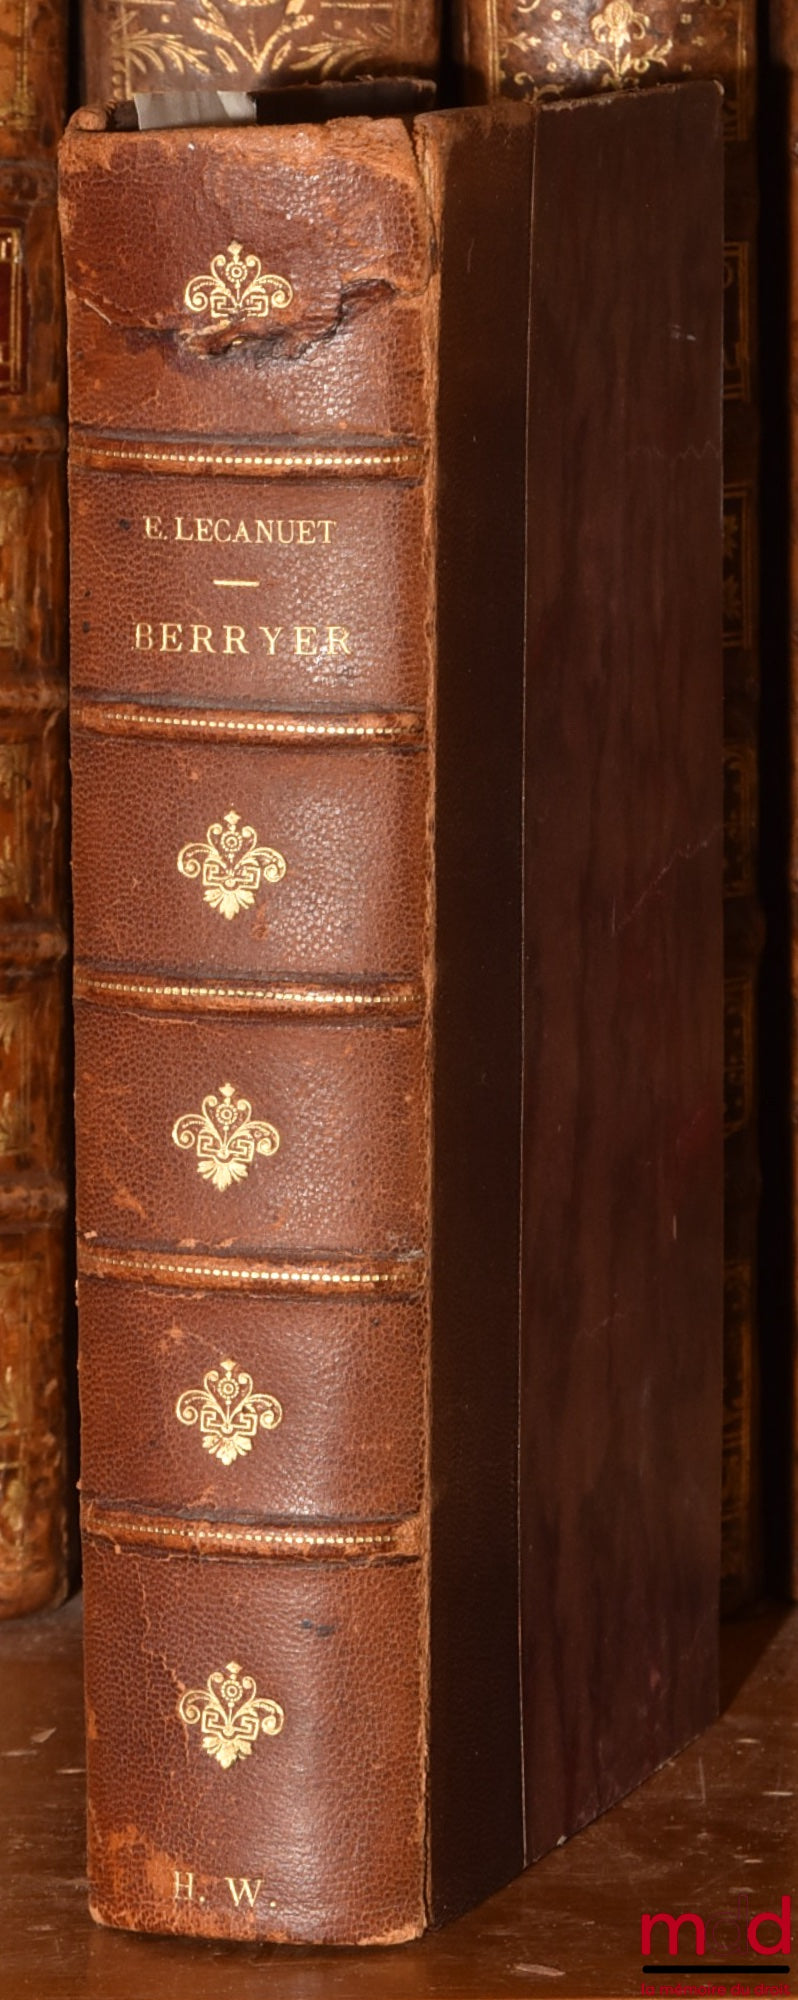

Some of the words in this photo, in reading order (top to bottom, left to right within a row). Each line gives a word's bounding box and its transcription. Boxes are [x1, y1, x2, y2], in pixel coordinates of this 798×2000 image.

[143, 515, 168, 540] E.
[174, 516, 336, 544] LECANUET
[134, 621, 352, 656] BERRYER
[174, 1870, 205, 1902] H.
[224, 1876, 277, 1908] W.
